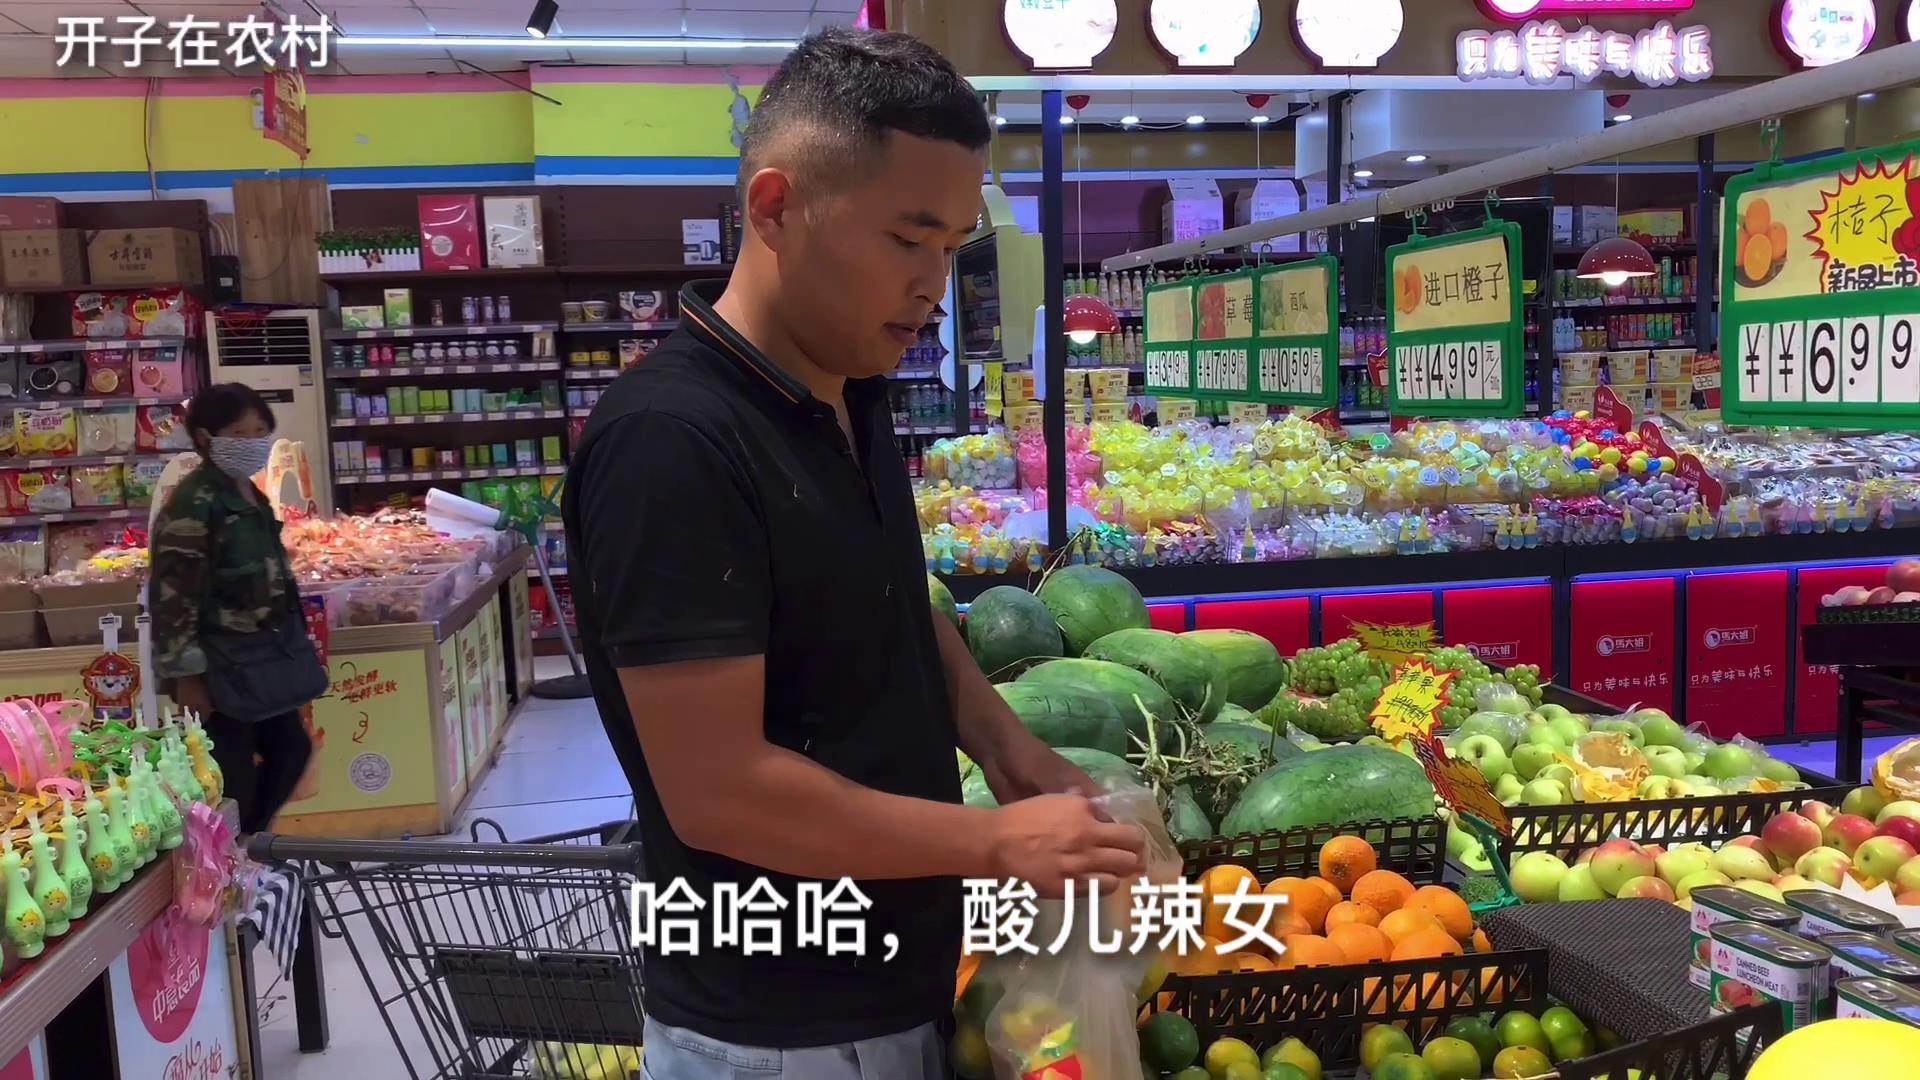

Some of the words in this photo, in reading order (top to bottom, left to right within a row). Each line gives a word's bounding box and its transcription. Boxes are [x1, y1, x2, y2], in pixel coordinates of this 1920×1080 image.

[1461, 24, 1710, 82] 只为美味与快乐
[1424, 263, 1504, 306] 进口橙子
[1828, 256, 1918, 293] 新品上市
[1289, 291, 1309, 312] 西瓜
[1582, 672, 1669, 692] 只为美味与快乐
[1691, 664, 1773, 685] 只为美味与快乐
[1736, 957, 1758, 974] CANNED
[1757, 965, 1770, 978] BEEF
[1736, 969, 1766, 986] LUNCHEON
[1765, 980, 1779, 992] MEAT
